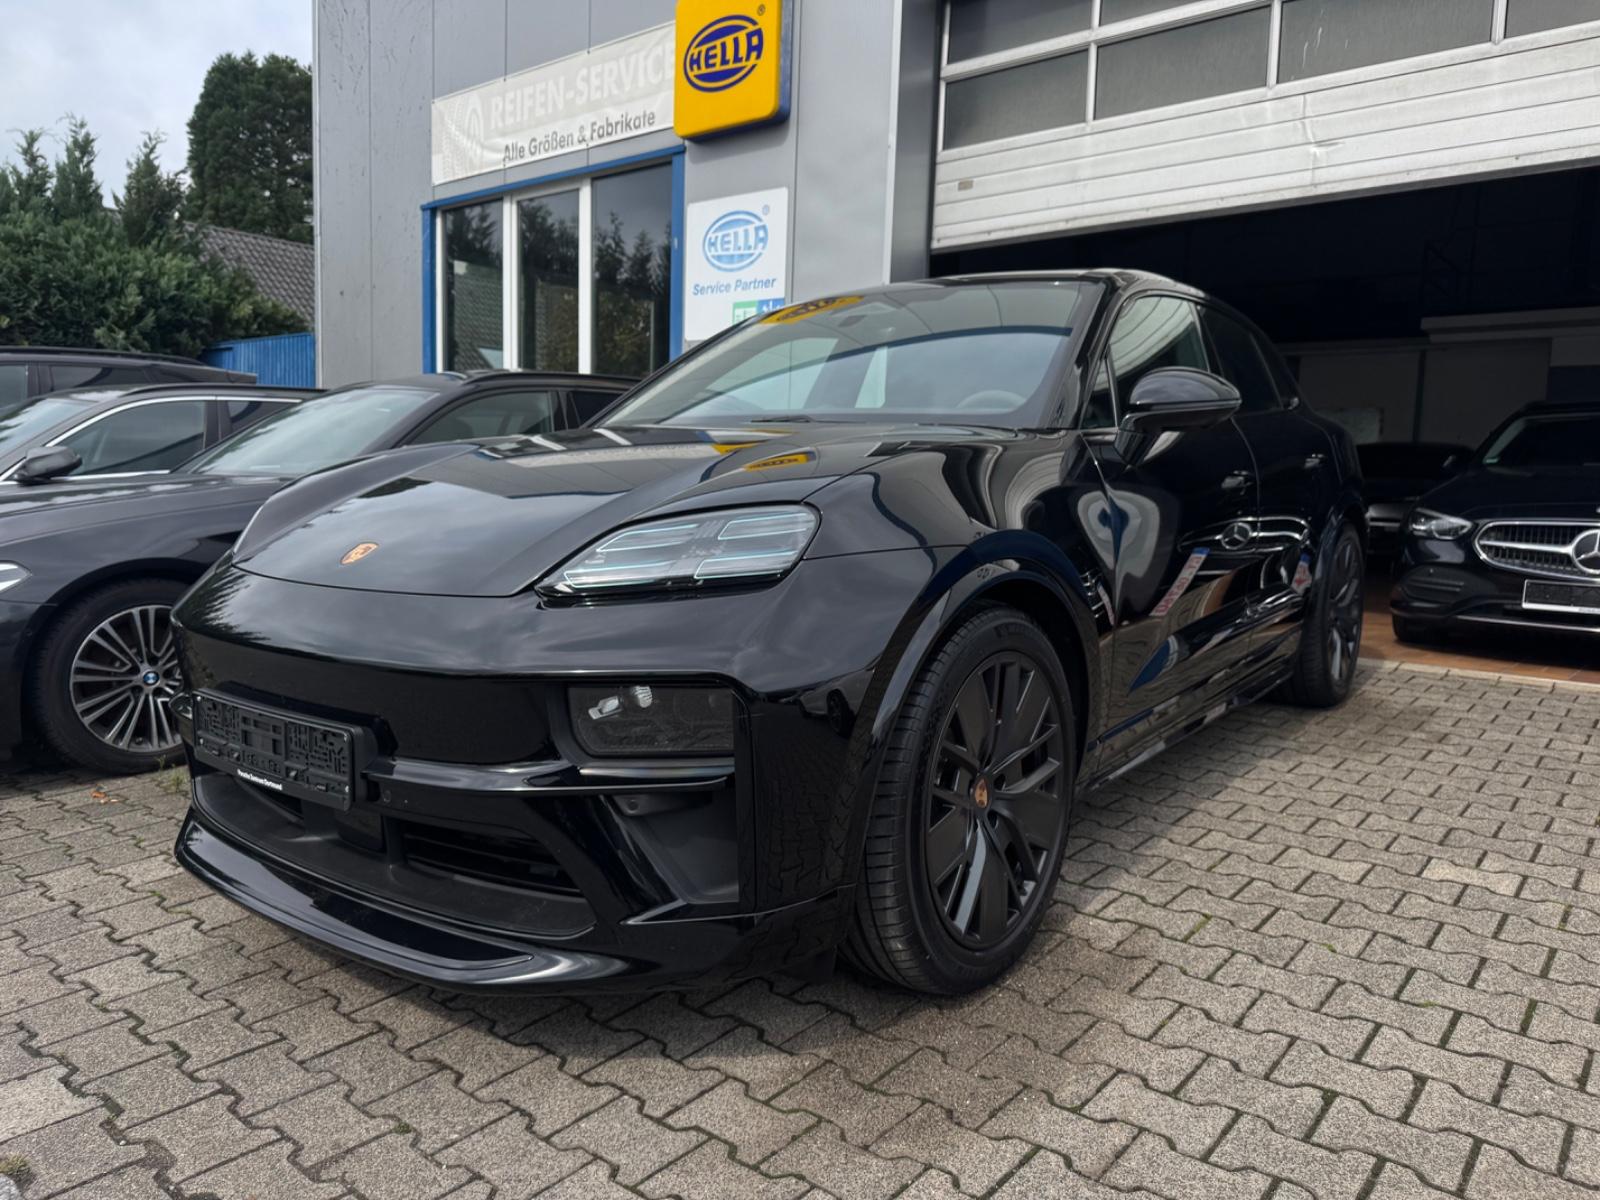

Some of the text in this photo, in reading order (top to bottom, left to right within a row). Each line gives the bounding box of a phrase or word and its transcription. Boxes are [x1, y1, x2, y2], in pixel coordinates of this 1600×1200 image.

[689, 27, 764, 72] HELLA
[503, 109, 656, 162] Alle Größen & Fabrikate
[708, 224, 769, 253] HELLA
[692, 278, 777, 296] Service Partner
